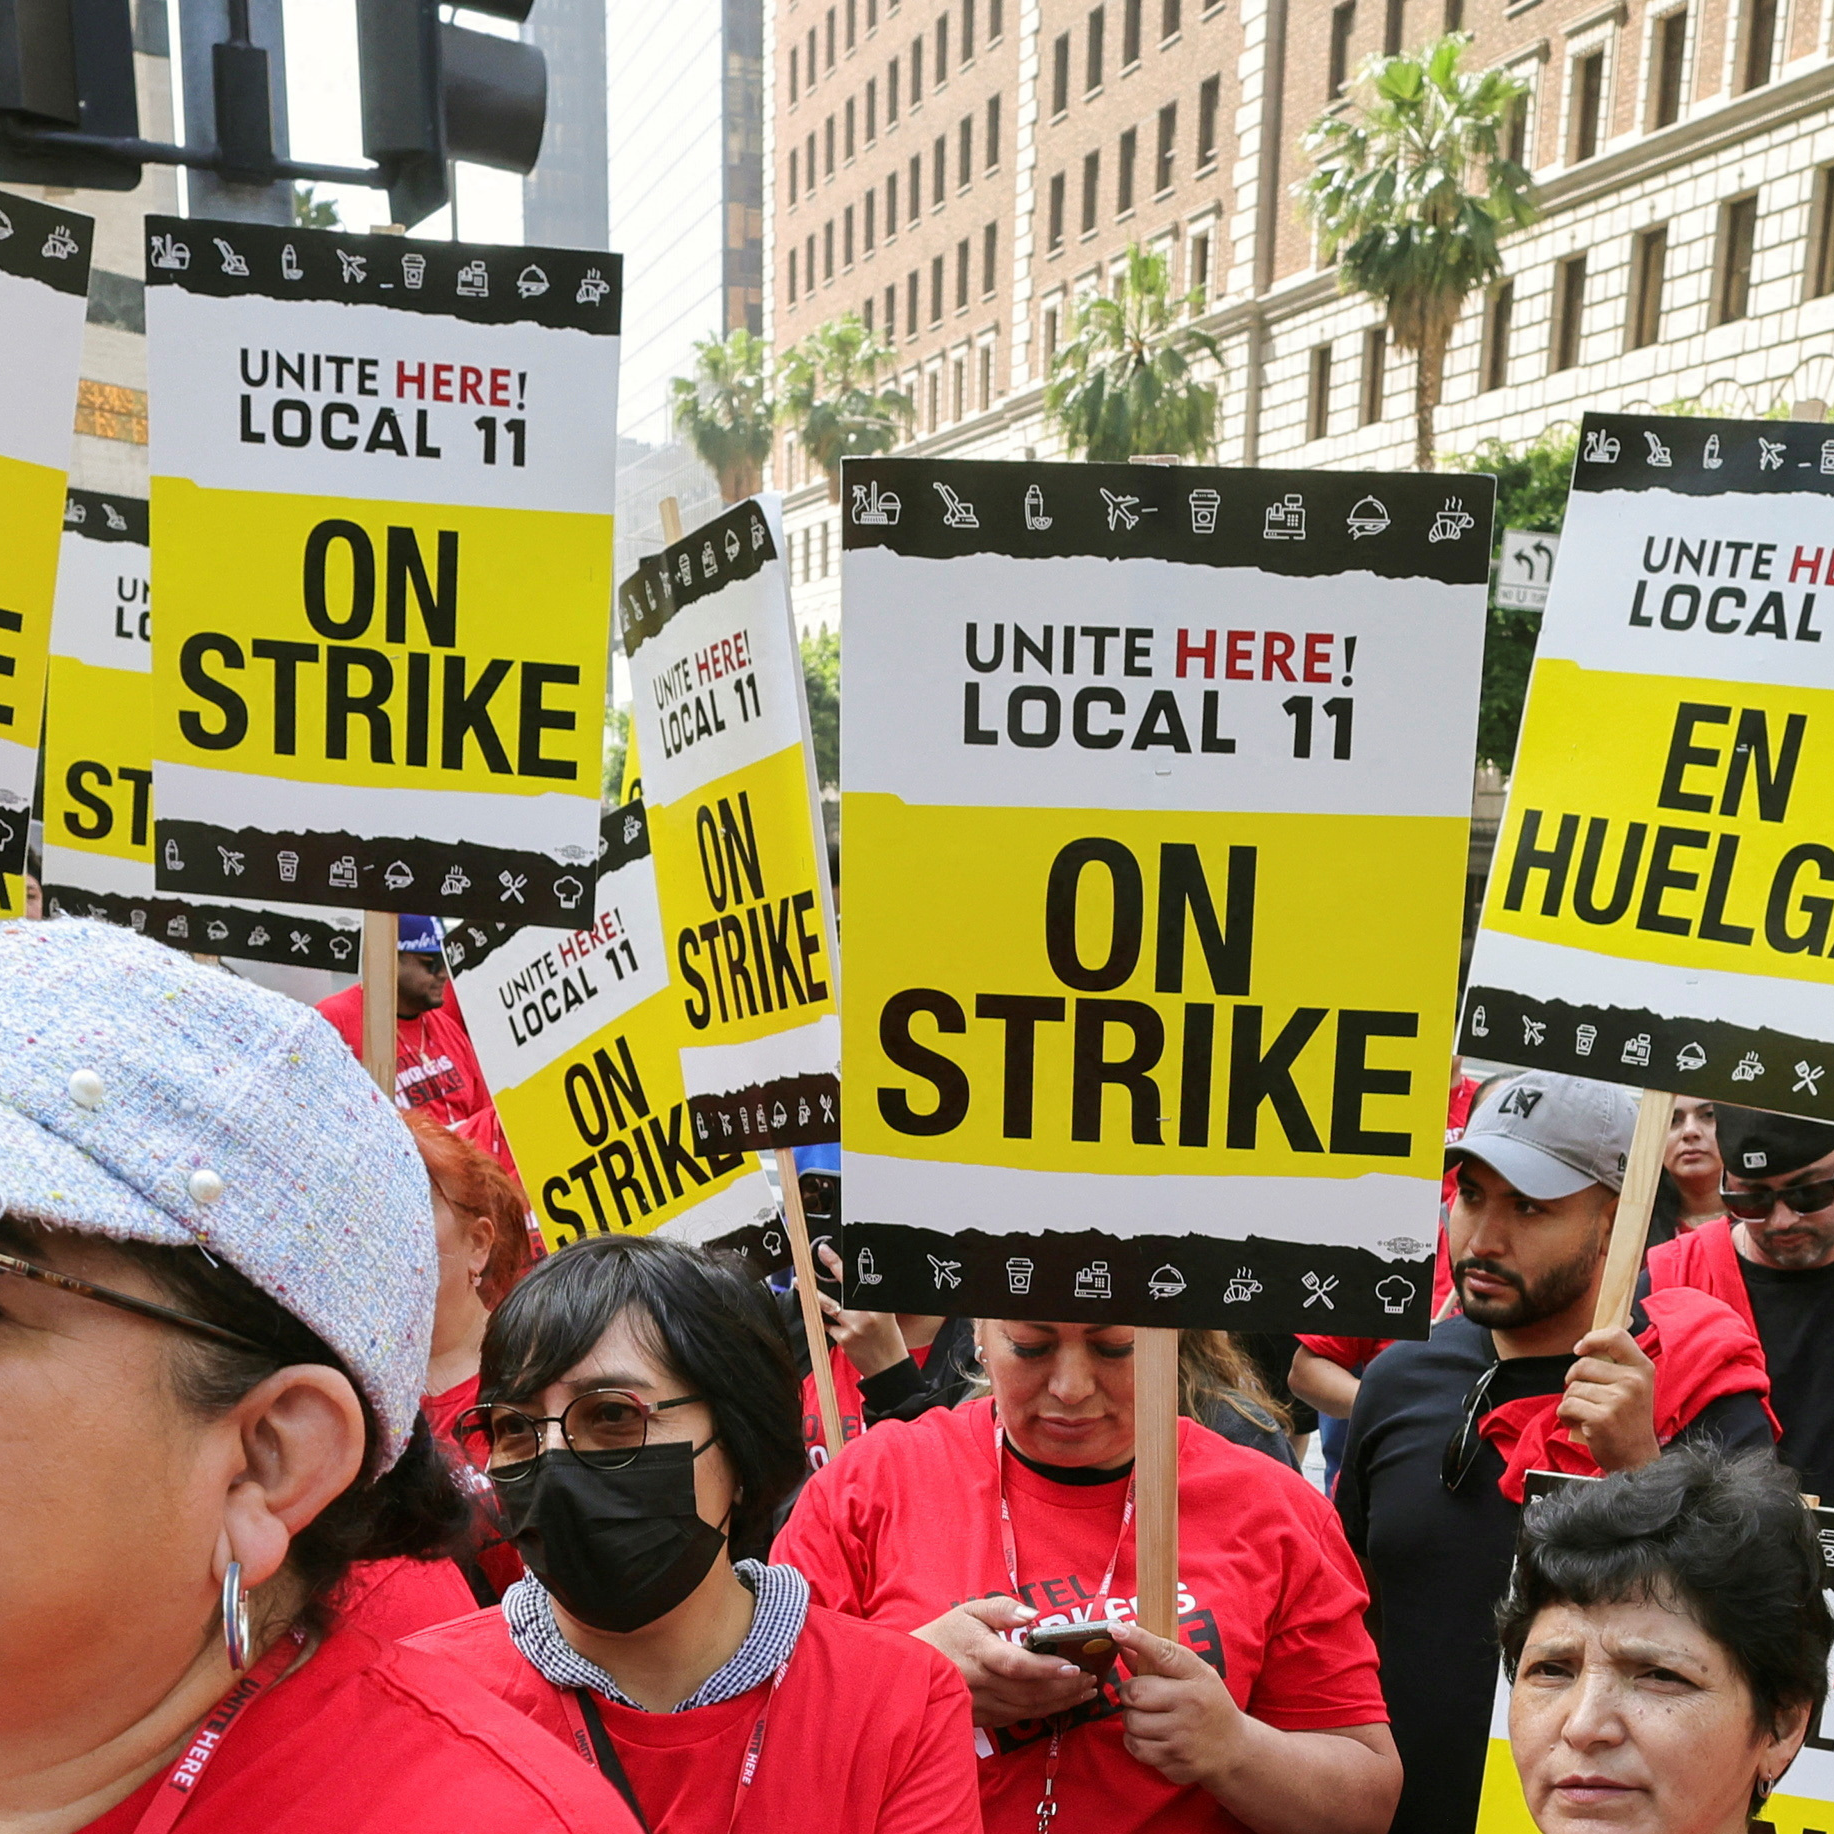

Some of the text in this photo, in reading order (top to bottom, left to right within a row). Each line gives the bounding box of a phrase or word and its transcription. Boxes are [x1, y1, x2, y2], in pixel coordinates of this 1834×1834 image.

[239, 348, 528, 410] UNITE HERE!
[239, 394, 527, 468] LOCAL 11
[302, 519, 459, 649] ON
[1628, 580, 1823, 642] LOCAL
[1642, 535, 1777, 581] UNITE
[176, 631, 581, 781] STRIKE
[652, 628, 753, 712] UNITE HERE!
[964, 621, 1358, 687] UNITE HERE!
[659, 672, 763, 761] LOCAL 11
[963, 682, 1355, 761] LOCAL 11
[1657, 701, 1808, 824] EN
[695, 791, 766, 914] ON
[498, 908, 626, 1011] UNITE HERE!
[676, 889, 828, 1031] STRIKE
[1044, 836, 1258, 996] ON
[506, 938, 641, 1048] LOCAL 11
[564, 1034, 652, 1148] ON
[877, 987, 1420, 1158] STRIKE
[540, 1102, 744, 1249] STRIK
